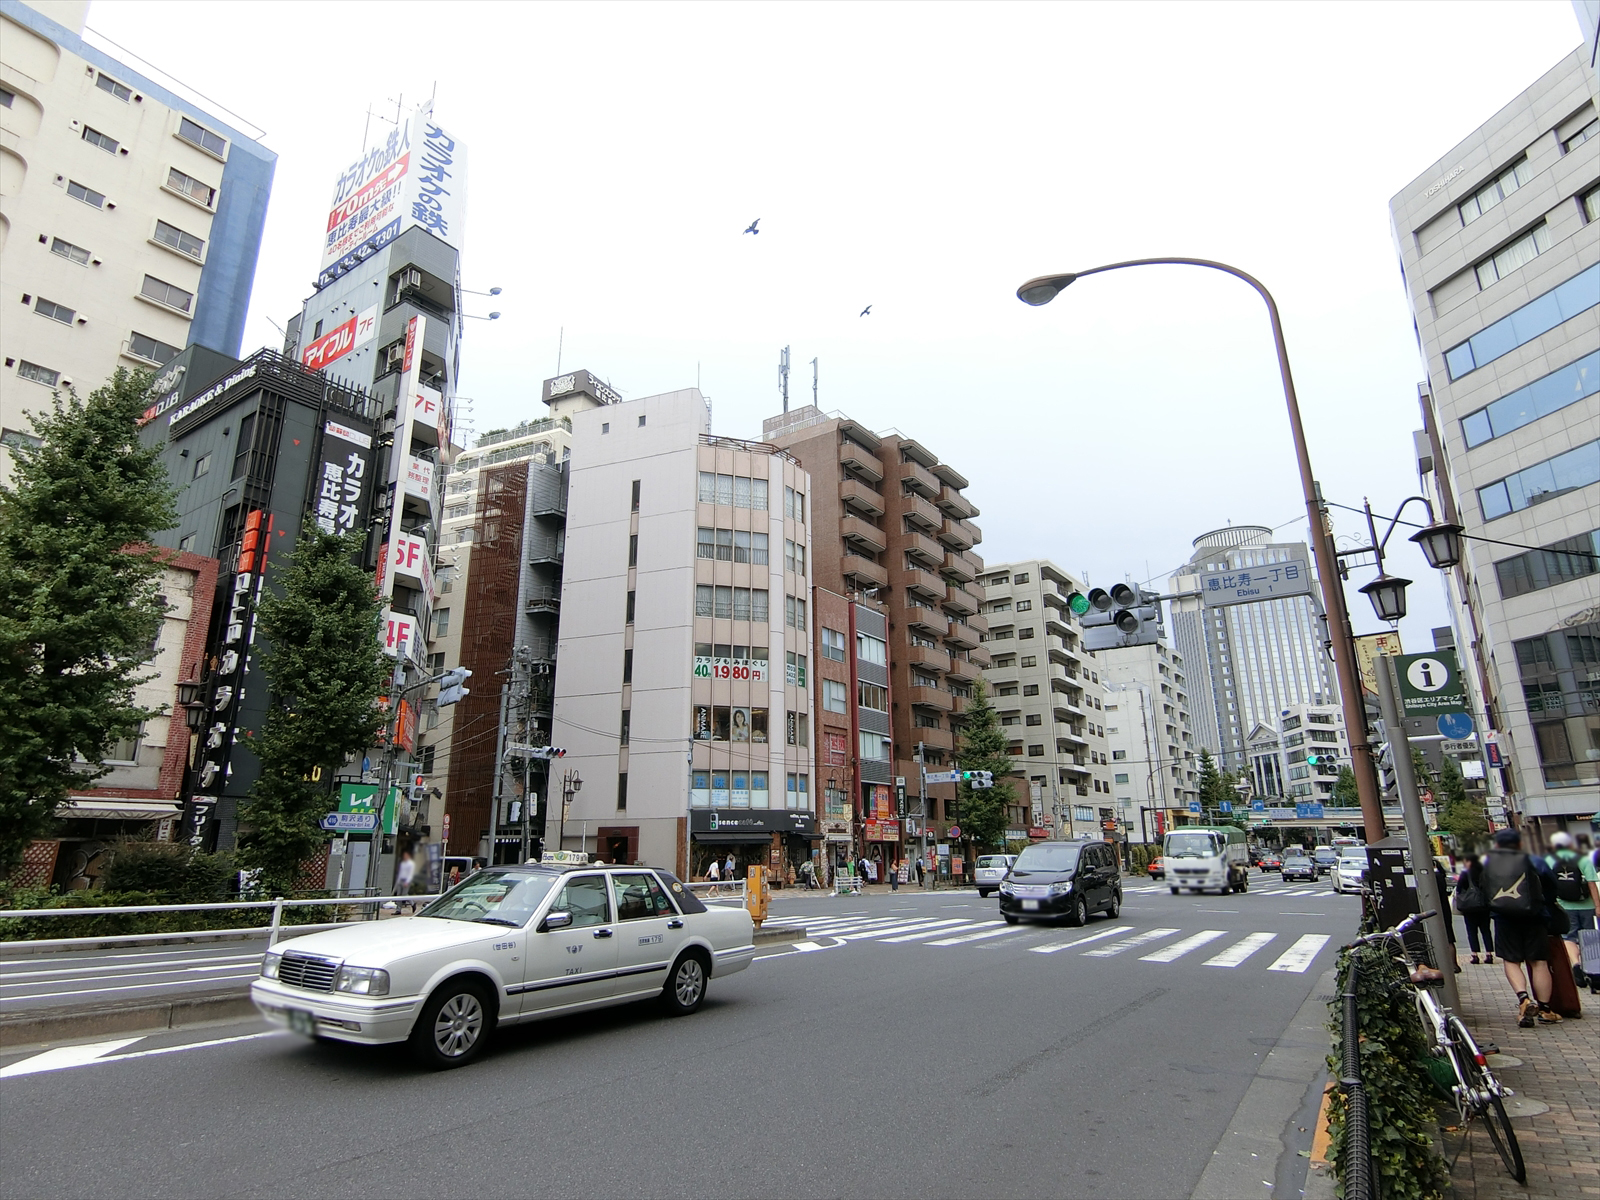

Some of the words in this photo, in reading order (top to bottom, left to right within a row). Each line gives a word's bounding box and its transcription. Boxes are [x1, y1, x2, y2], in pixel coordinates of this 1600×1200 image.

[334, 118, 411, 206] カラオケの鉄人
[411, 122, 455, 237] カラオケの鉄
[1424, 165, 1465, 198] YOSHIHARA
[359, 316, 374, 336] 7F
[305, 327, 353, 367] アイフル
[405, 331, 416, 368] アイフル
[169, 389, 215, 427] KARAOKE
[223, 364, 258, 392] Dining
[414, 394, 436, 415] 7F
[338, 452, 366, 536] カラオ
[396, 539, 421, 569] 5F
[1207, 565, 1300, 592] 恵比寿一丁目
[1237, 587, 1261, 598] Ebisu
[1268, 585, 1274, 593] 1
[386, 620, 411, 649] 4F
[696, 657, 767, 667] カラダもみほぐし
[1404, 693, 1461, 705] 渋谷区エリアマップ
[201, 649, 240, 789] カラオケ
[1444, 742, 1476, 751] 歩行者優先
[341, 814, 372, 823] 駒沢通り
[569, 854, 580, 862] 179
[492, 941, 517, 951] (世田谷)
[651, 934, 662, 944] 179
[565, 967, 583, 976] TAXI
